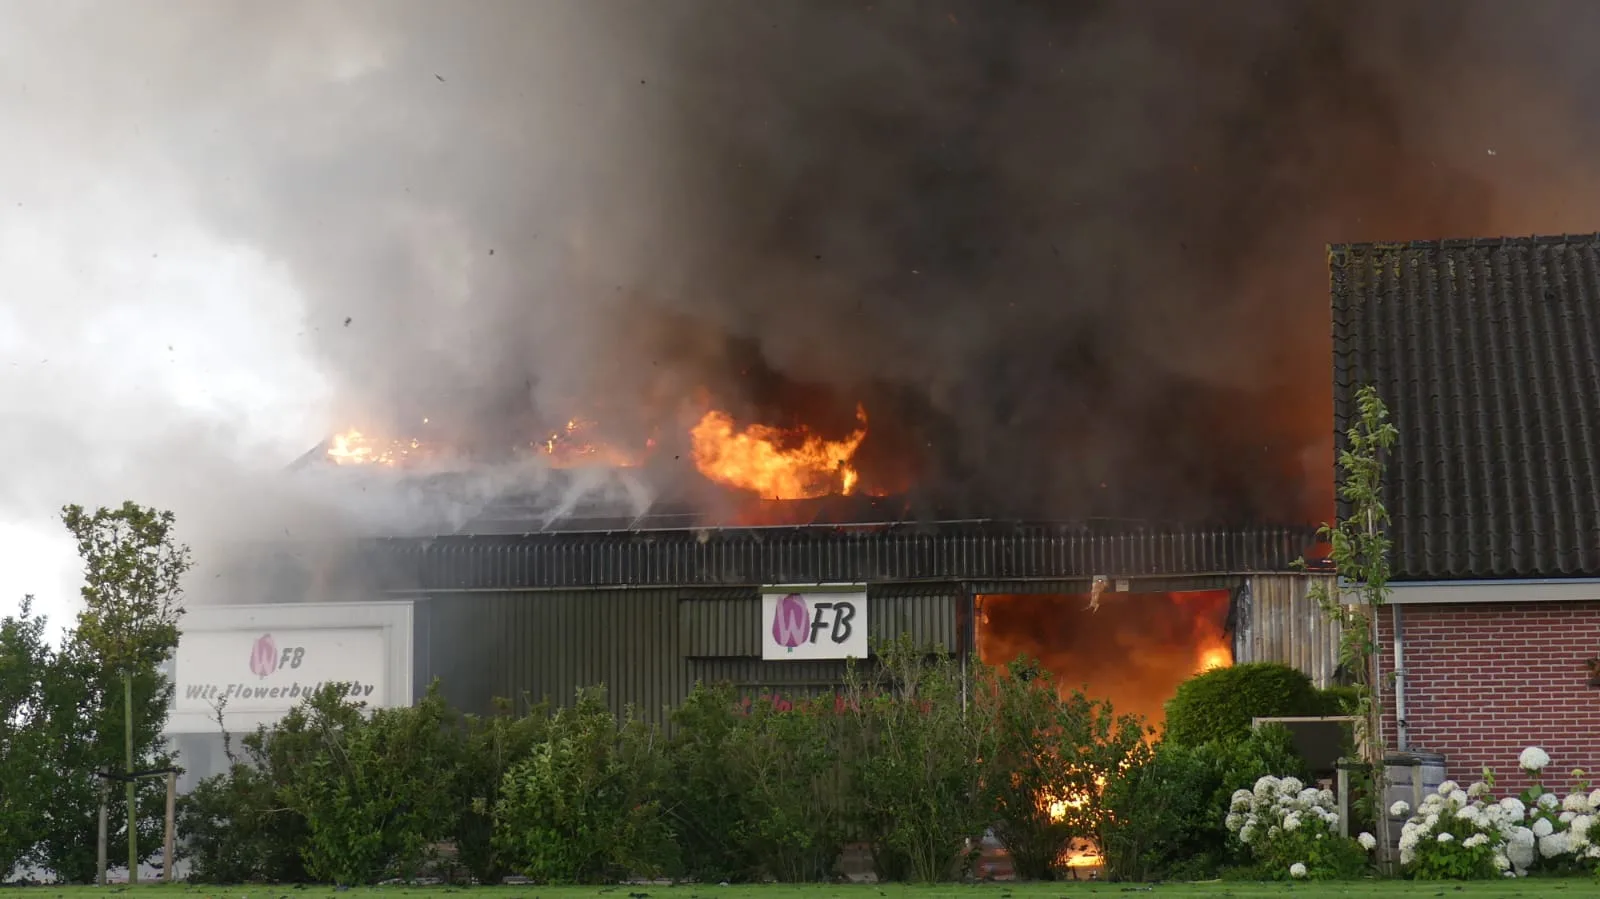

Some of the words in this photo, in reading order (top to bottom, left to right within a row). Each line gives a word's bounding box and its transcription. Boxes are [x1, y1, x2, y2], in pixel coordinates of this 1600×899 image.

[772, 593, 856, 648] WFB
[250, 634, 305, 676] WFB
[185, 683, 218, 700] Wit
